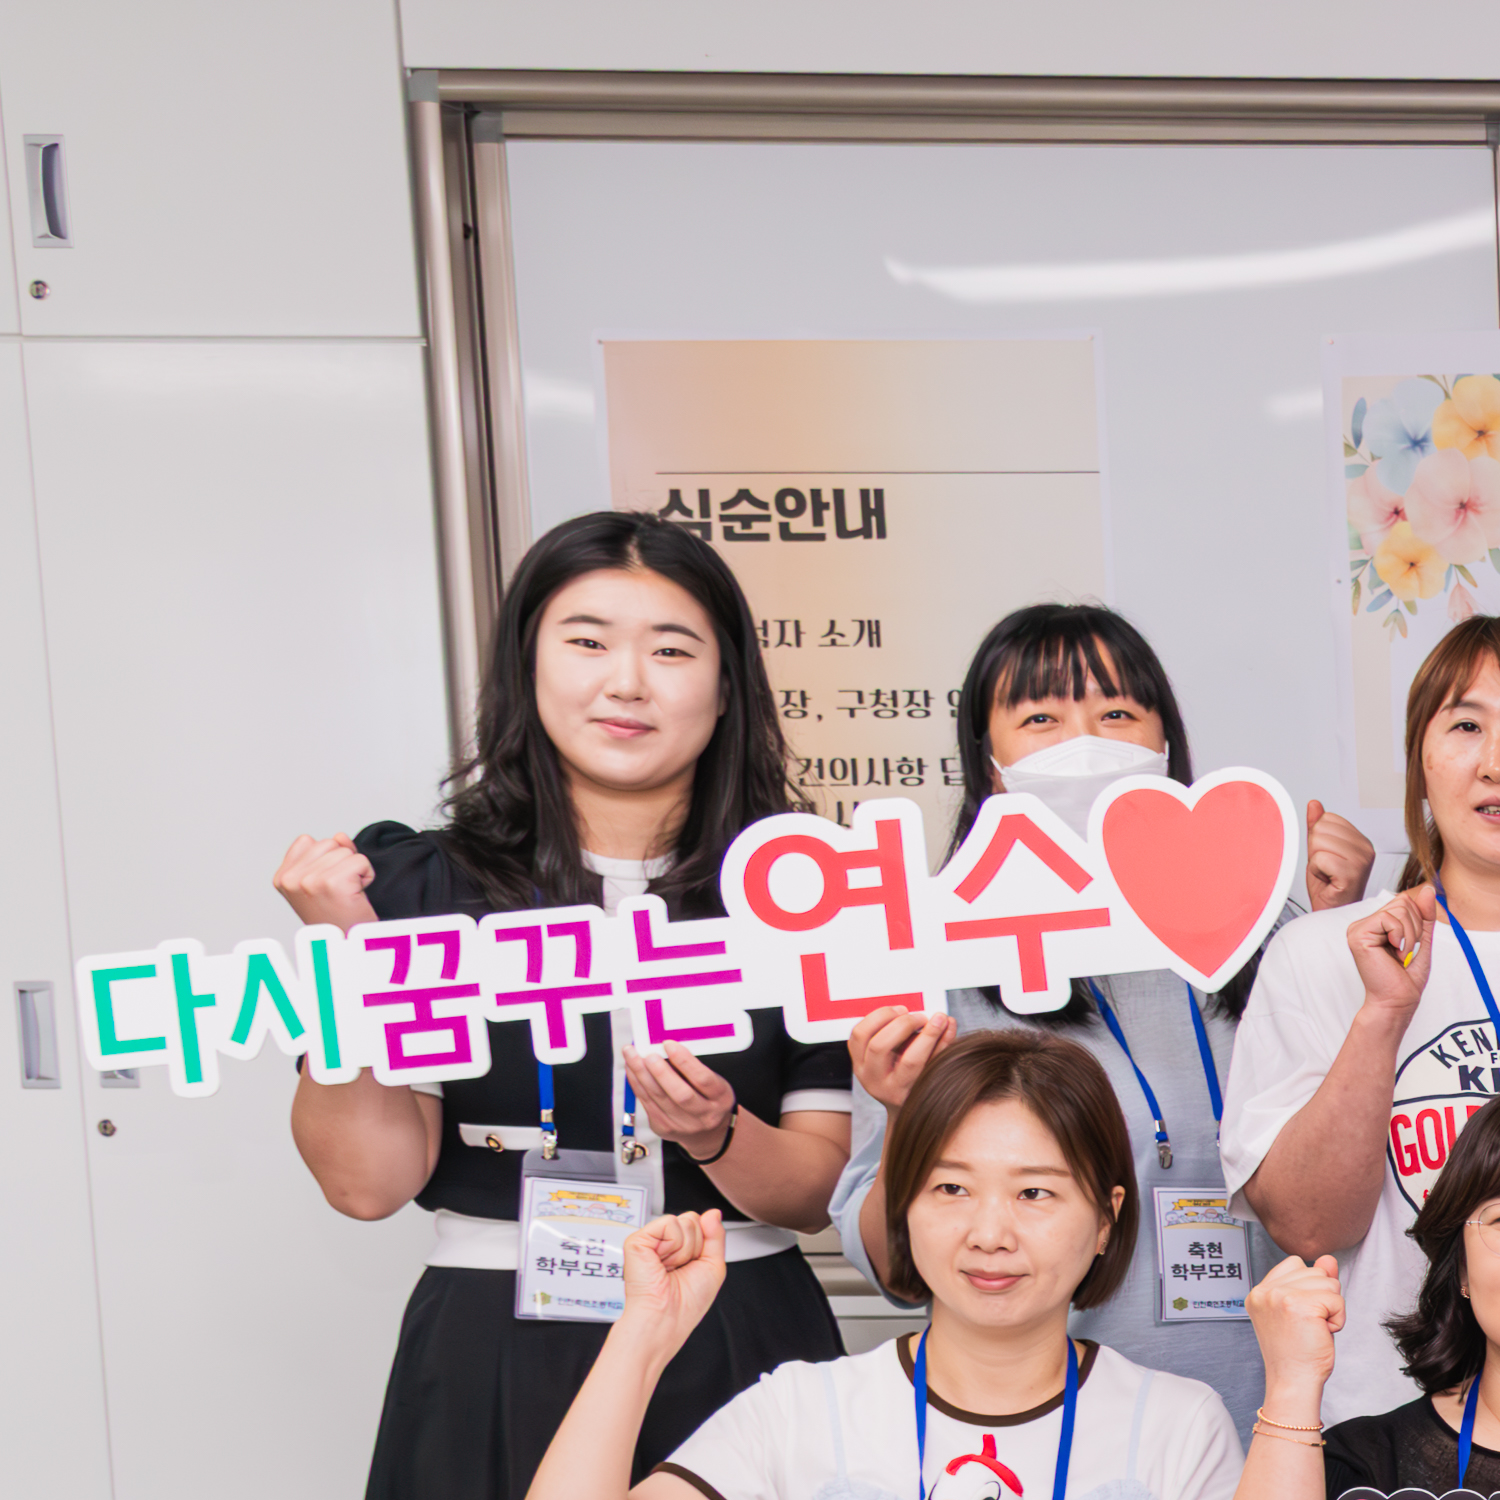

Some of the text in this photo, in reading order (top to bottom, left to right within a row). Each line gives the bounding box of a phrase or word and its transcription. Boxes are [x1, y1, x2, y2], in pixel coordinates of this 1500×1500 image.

[658, 487, 887, 542] 식순안내
[818, 618, 882, 648] 소개
[836, 688, 935, 719] 구청장
[1187, 1241, 1223, 1259] 축현
[1171, 1262, 1242, 1281] 학부모회
